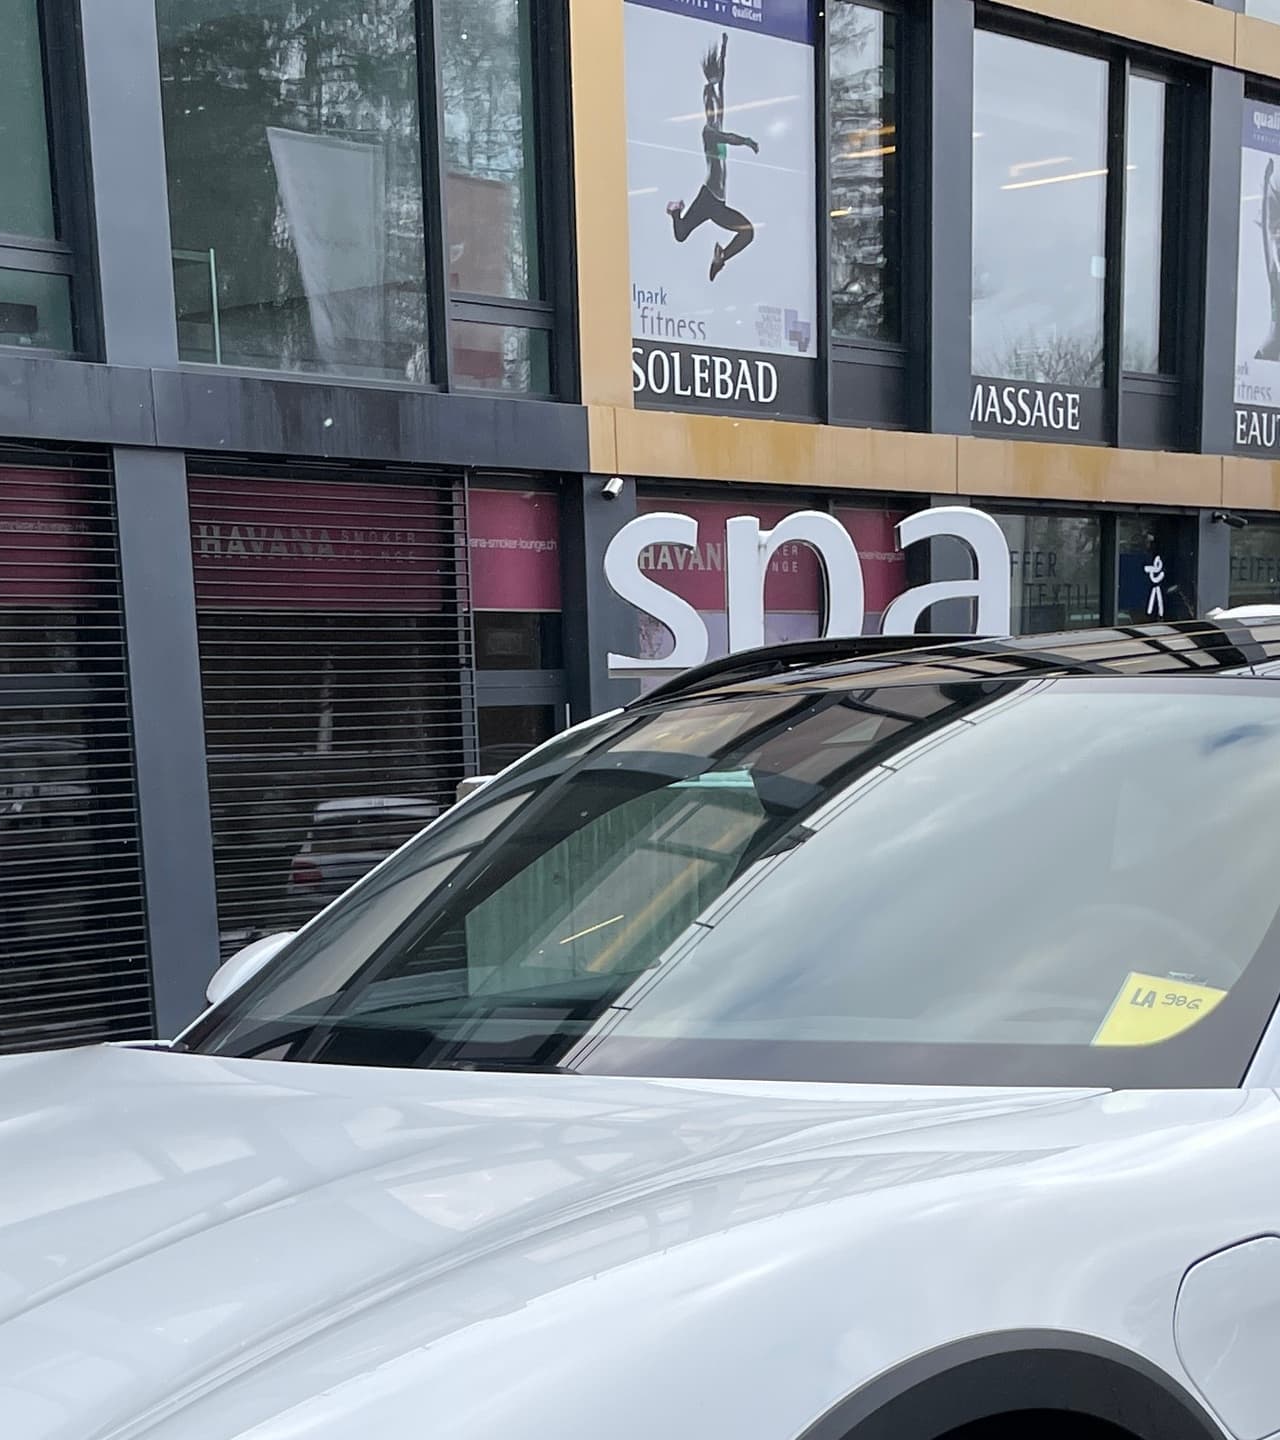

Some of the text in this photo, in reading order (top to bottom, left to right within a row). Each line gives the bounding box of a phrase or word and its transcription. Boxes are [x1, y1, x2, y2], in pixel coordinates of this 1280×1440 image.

[640, 306, 707, 341] fitness
[632, 347, 778, 403] SOLEBAD
[199, 525, 337, 561] HAVANA
[638, 543, 727, 572] HAVAN
[1129, 987, 1157, 1009] LA
